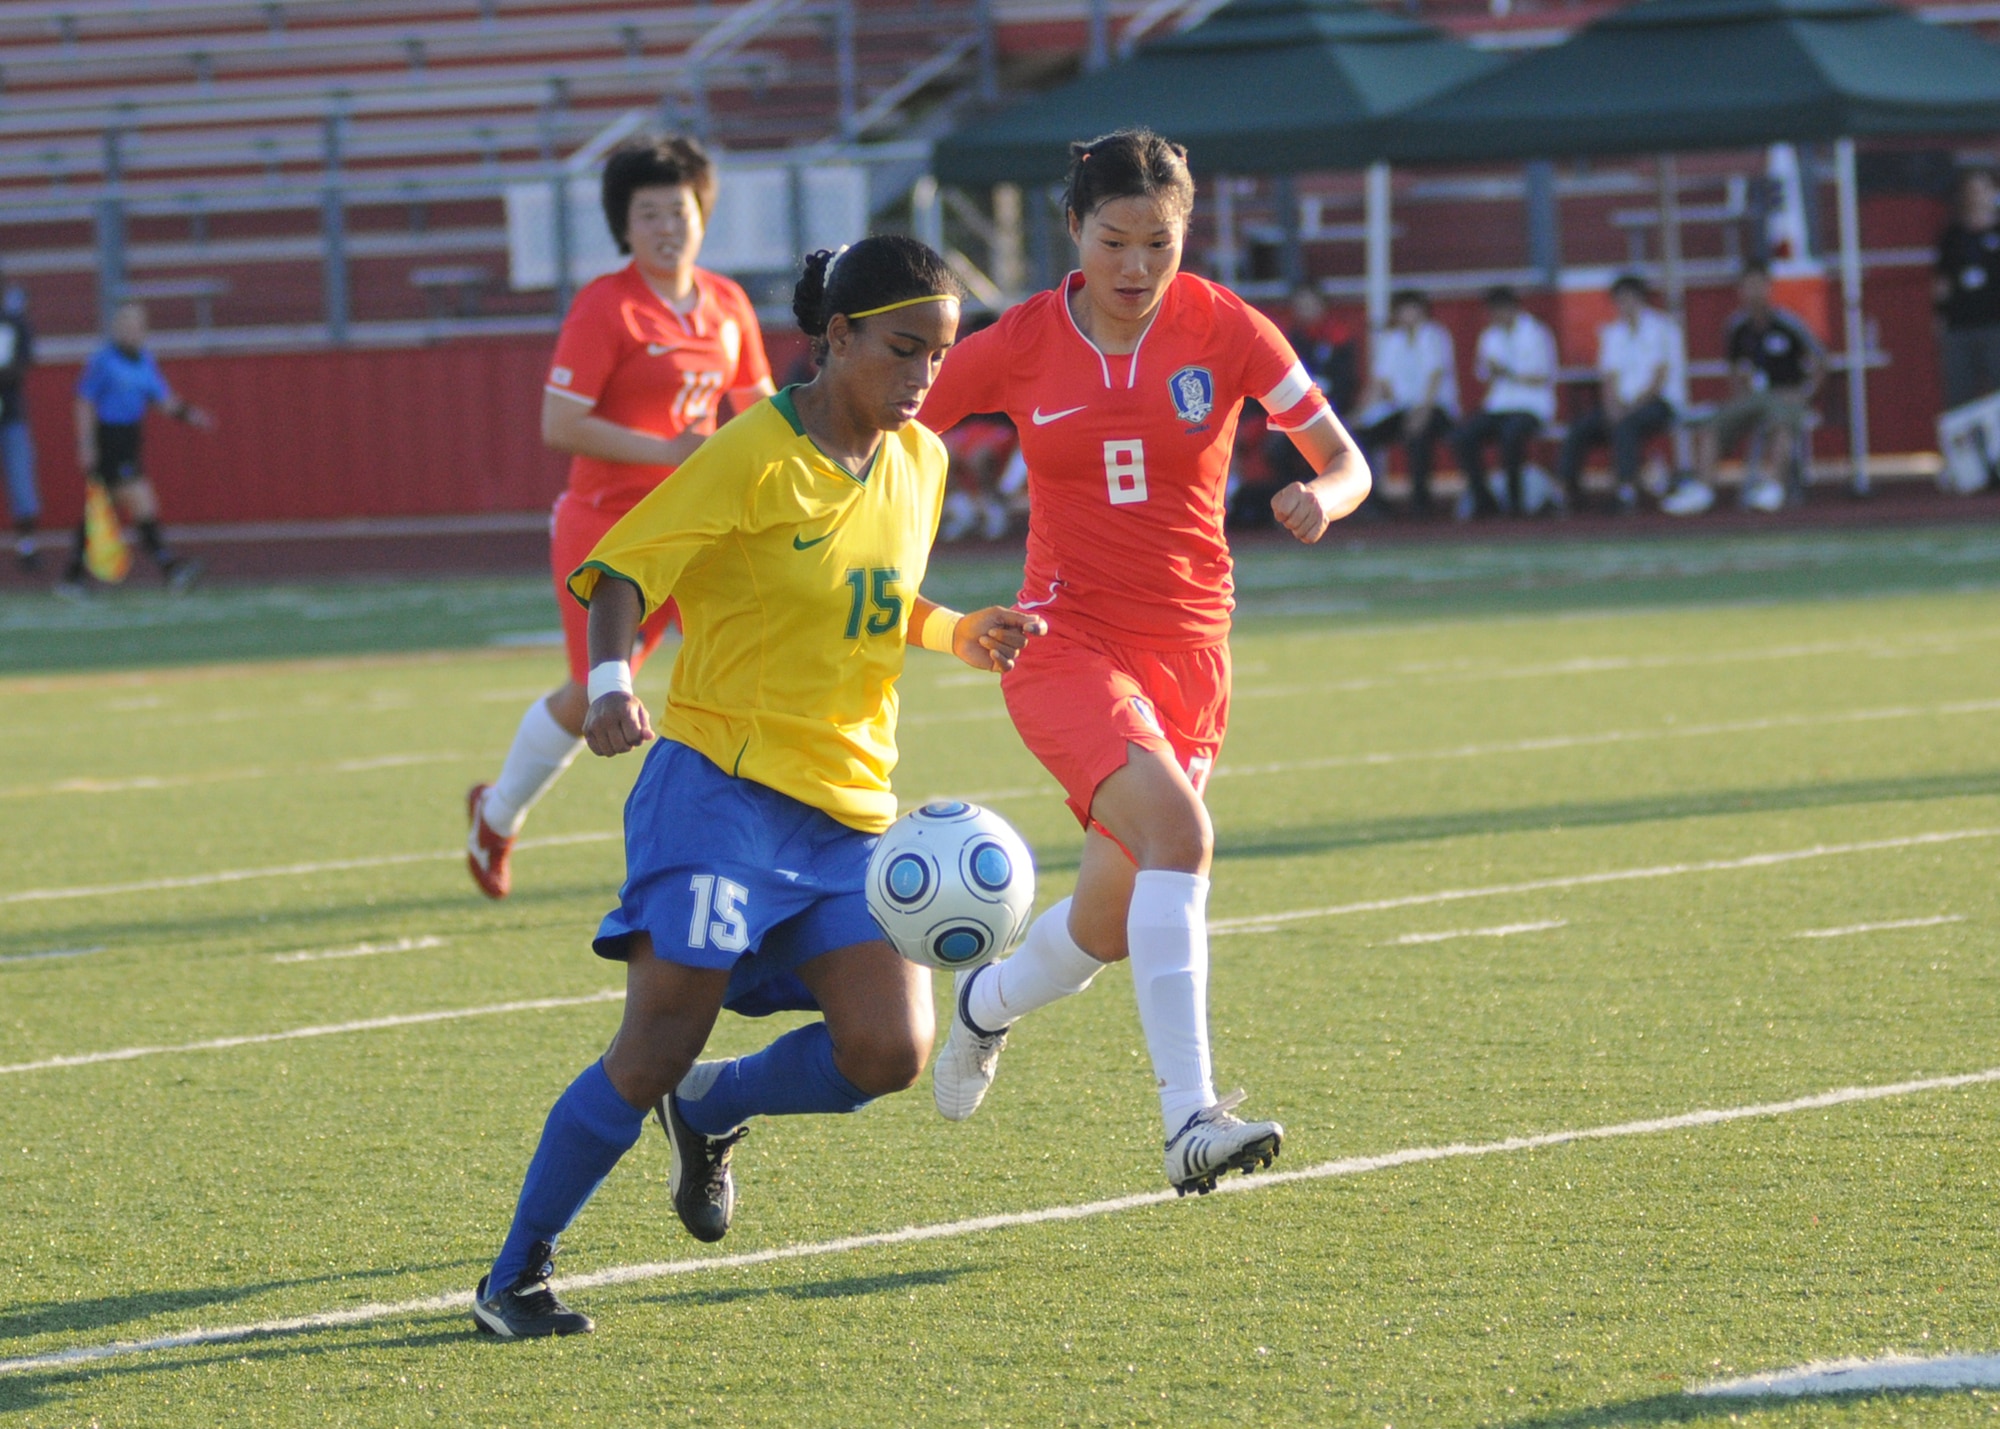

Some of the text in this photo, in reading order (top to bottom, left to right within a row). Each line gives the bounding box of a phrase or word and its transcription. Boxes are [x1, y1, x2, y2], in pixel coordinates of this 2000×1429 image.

[1103, 438, 1148, 505] 8
[844, 568, 904, 639] 15
[688, 874, 750, 953] 15
